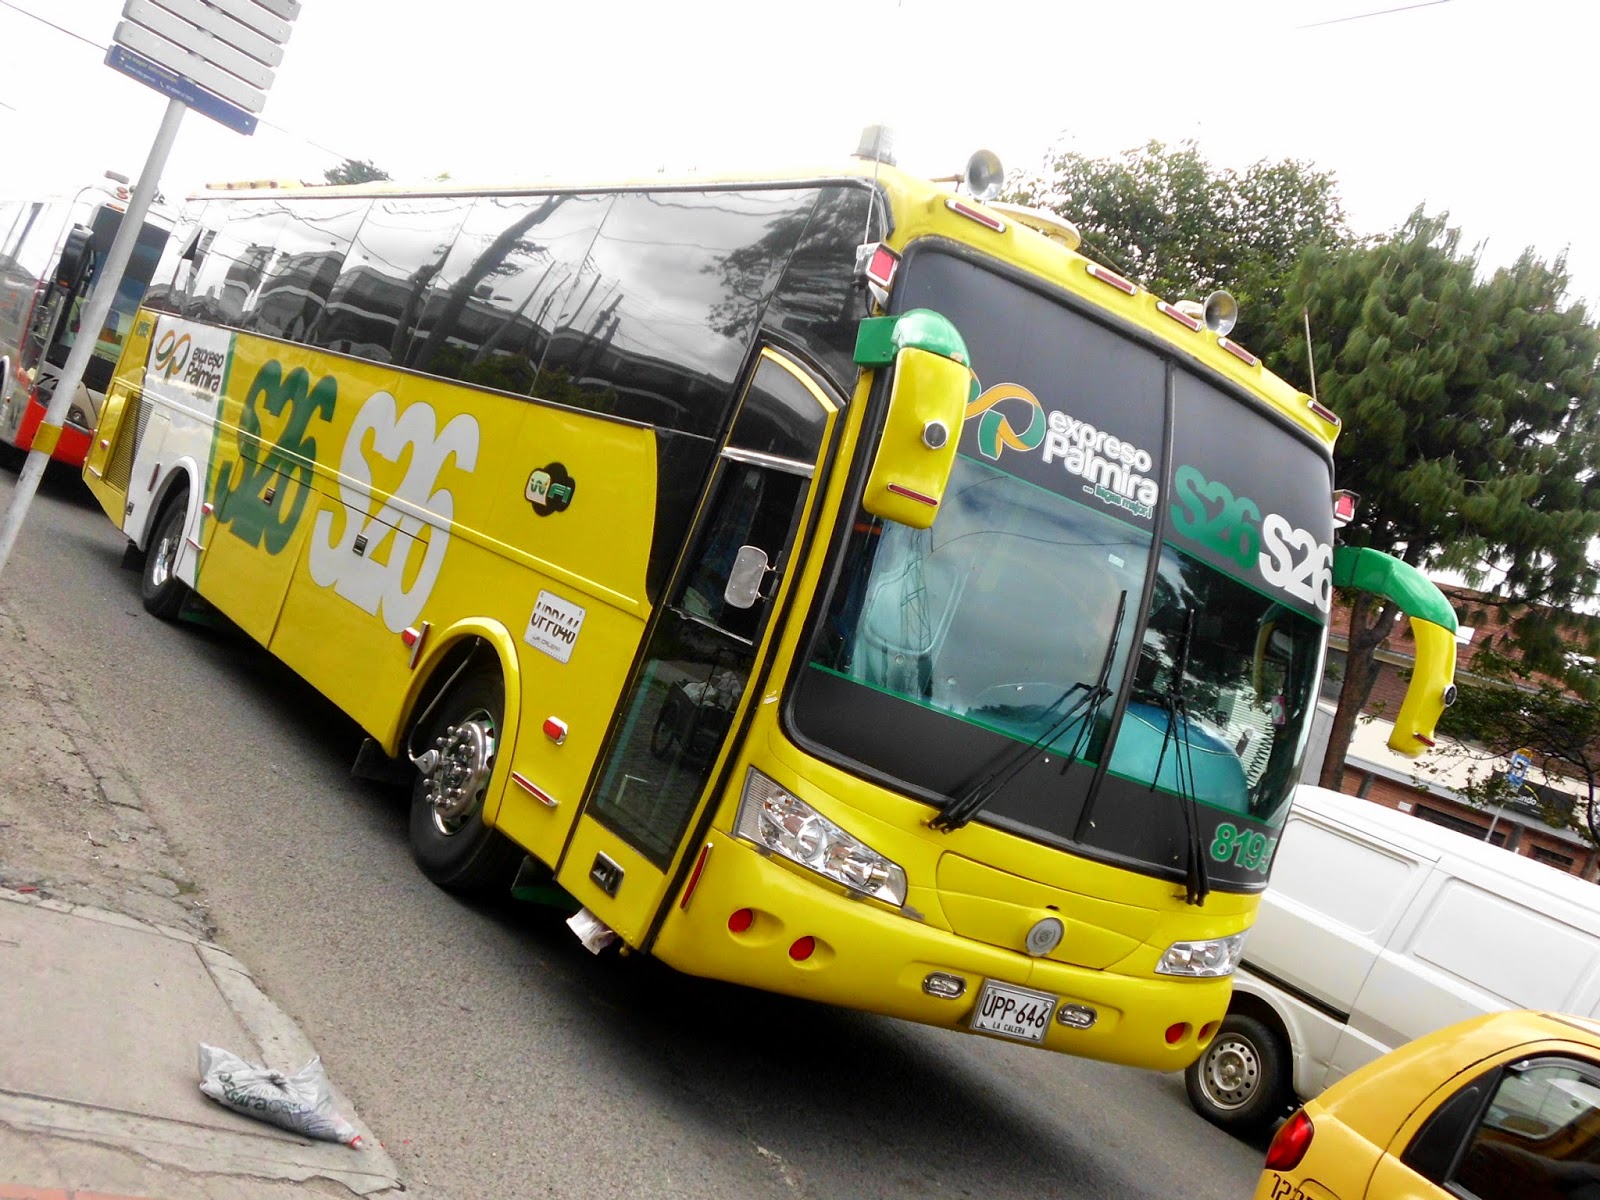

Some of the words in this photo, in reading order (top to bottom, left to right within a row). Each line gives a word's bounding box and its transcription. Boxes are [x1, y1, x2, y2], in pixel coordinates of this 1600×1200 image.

[184, 361, 221, 393] Palmira
[192, 347, 224, 369] expreso
[213, 359, 338, 555] S26
[1043, 429, 1159, 507] Palmira
[1048, 410, 1152, 472] expreso
[309, 390, 480, 633] S26
[1171, 465, 1261, 570] S26
[1259, 513, 1333, 613] S26
[993, 1021, 1001, 1029] LA
[1004, 1024, 1026, 1035] CALERA
